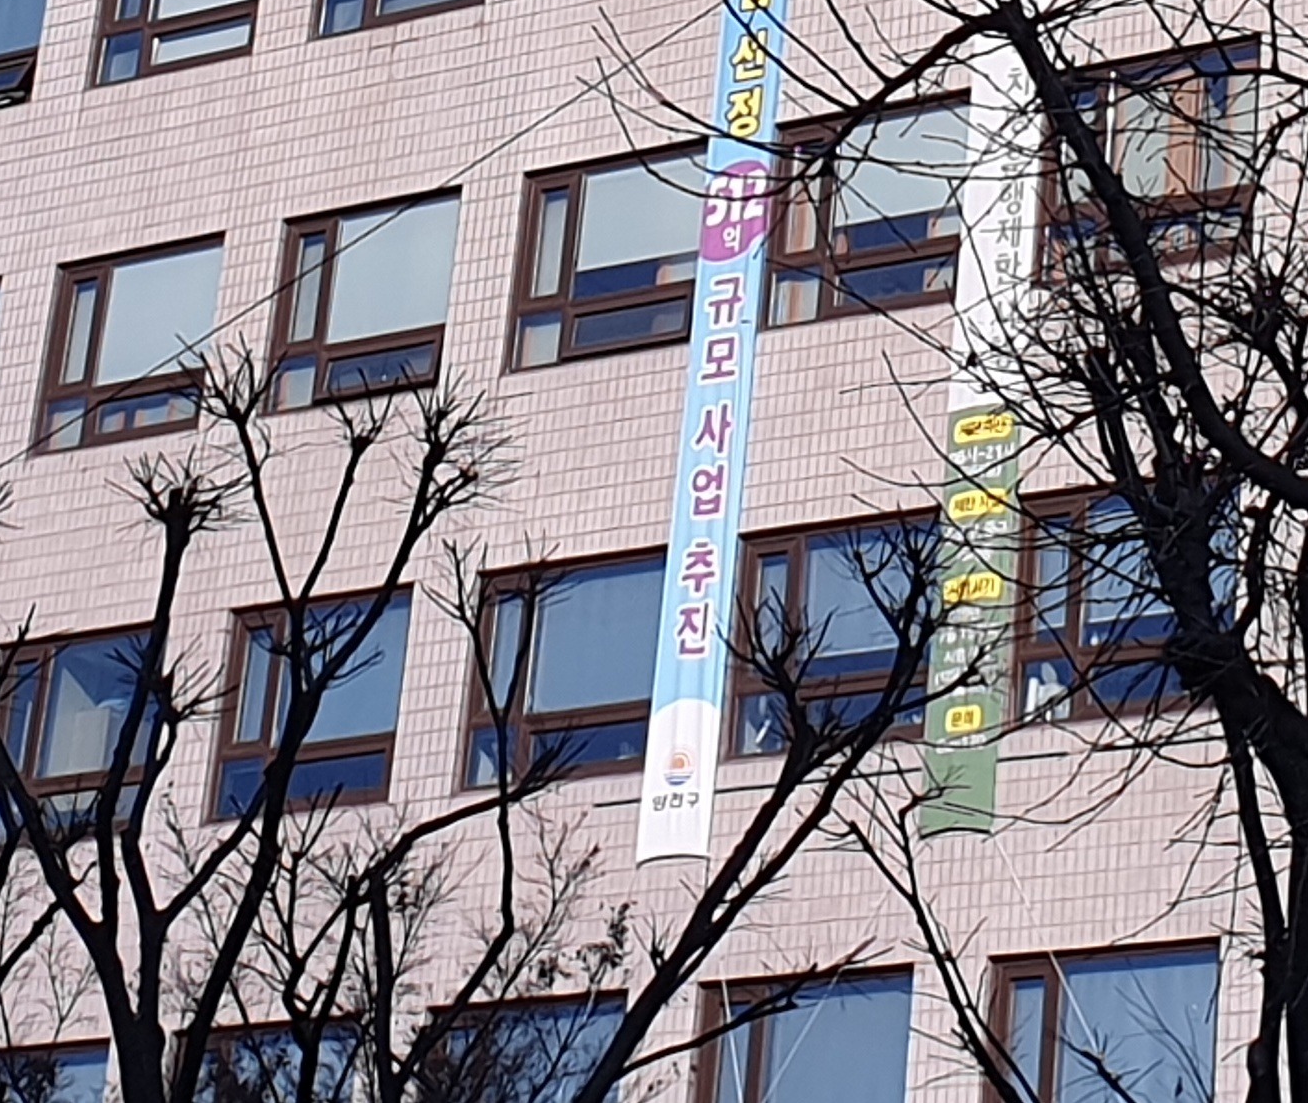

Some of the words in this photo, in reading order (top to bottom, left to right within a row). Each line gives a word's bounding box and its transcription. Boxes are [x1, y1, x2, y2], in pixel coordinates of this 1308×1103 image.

[725, 26, 768, 139] 선정
[705, 168, 767, 253] 512억
[697, 273, 744, 386] 규모
[691, 402, 733, 521] 사업
[675, 539, 719, 659] 추진
[652, 790, 700, 812] 양천구
